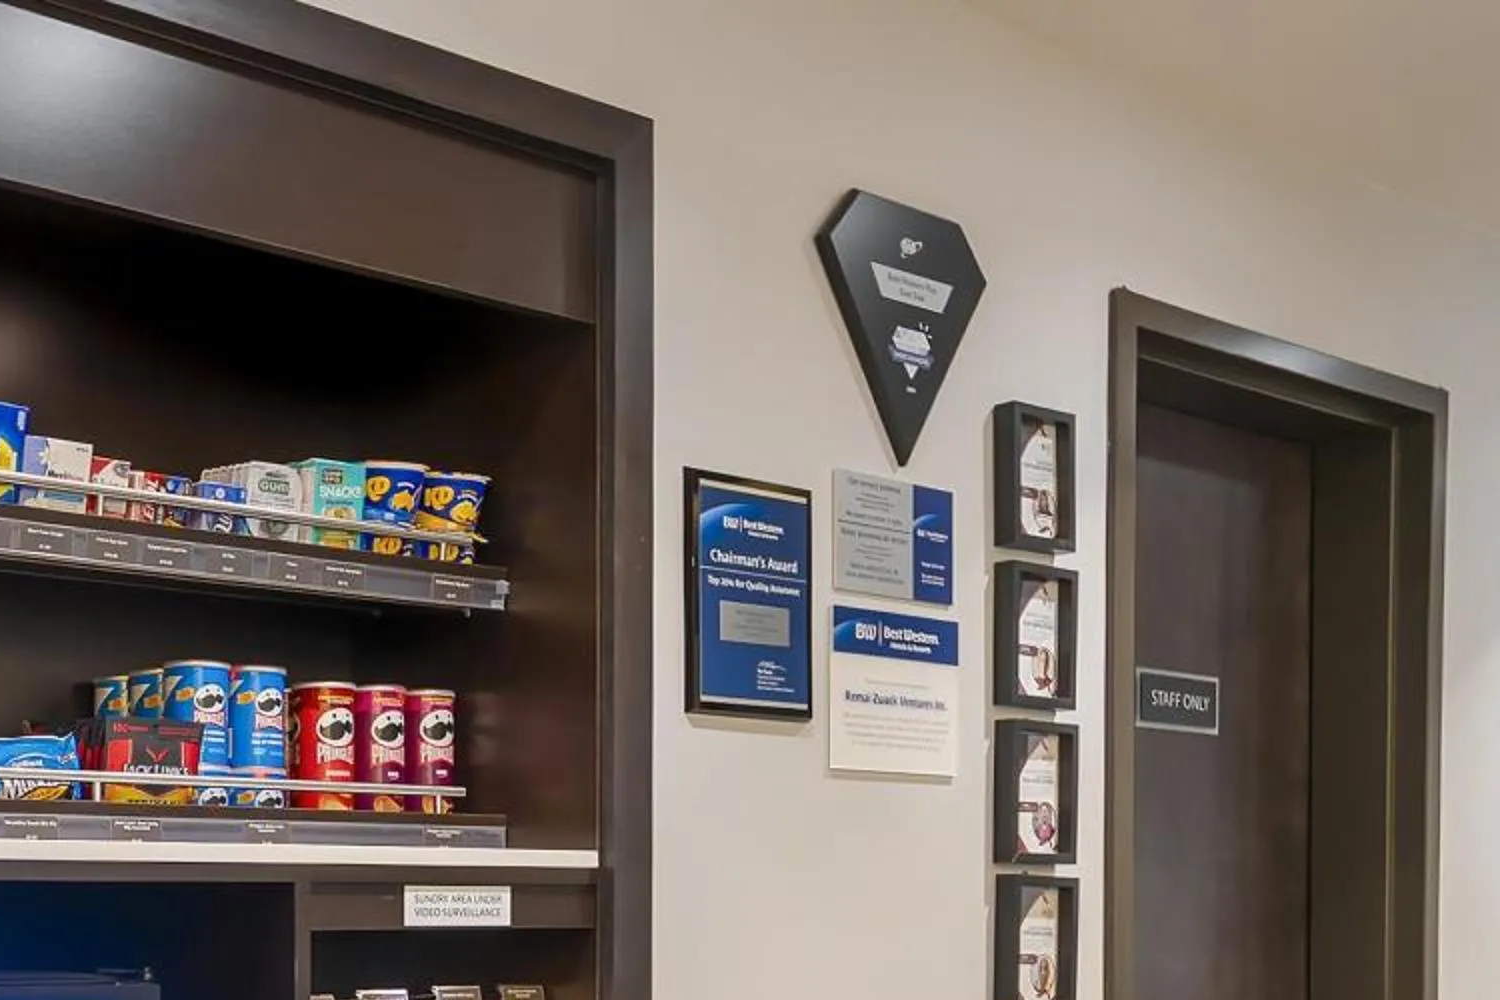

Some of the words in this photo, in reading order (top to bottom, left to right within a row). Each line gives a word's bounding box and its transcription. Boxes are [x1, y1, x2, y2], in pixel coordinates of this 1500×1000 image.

[709, 548, 767, 569] Chairman's
[1151, 689, 1181, 708] STAFF
[1183, 693, 1211, 712] ONLY
